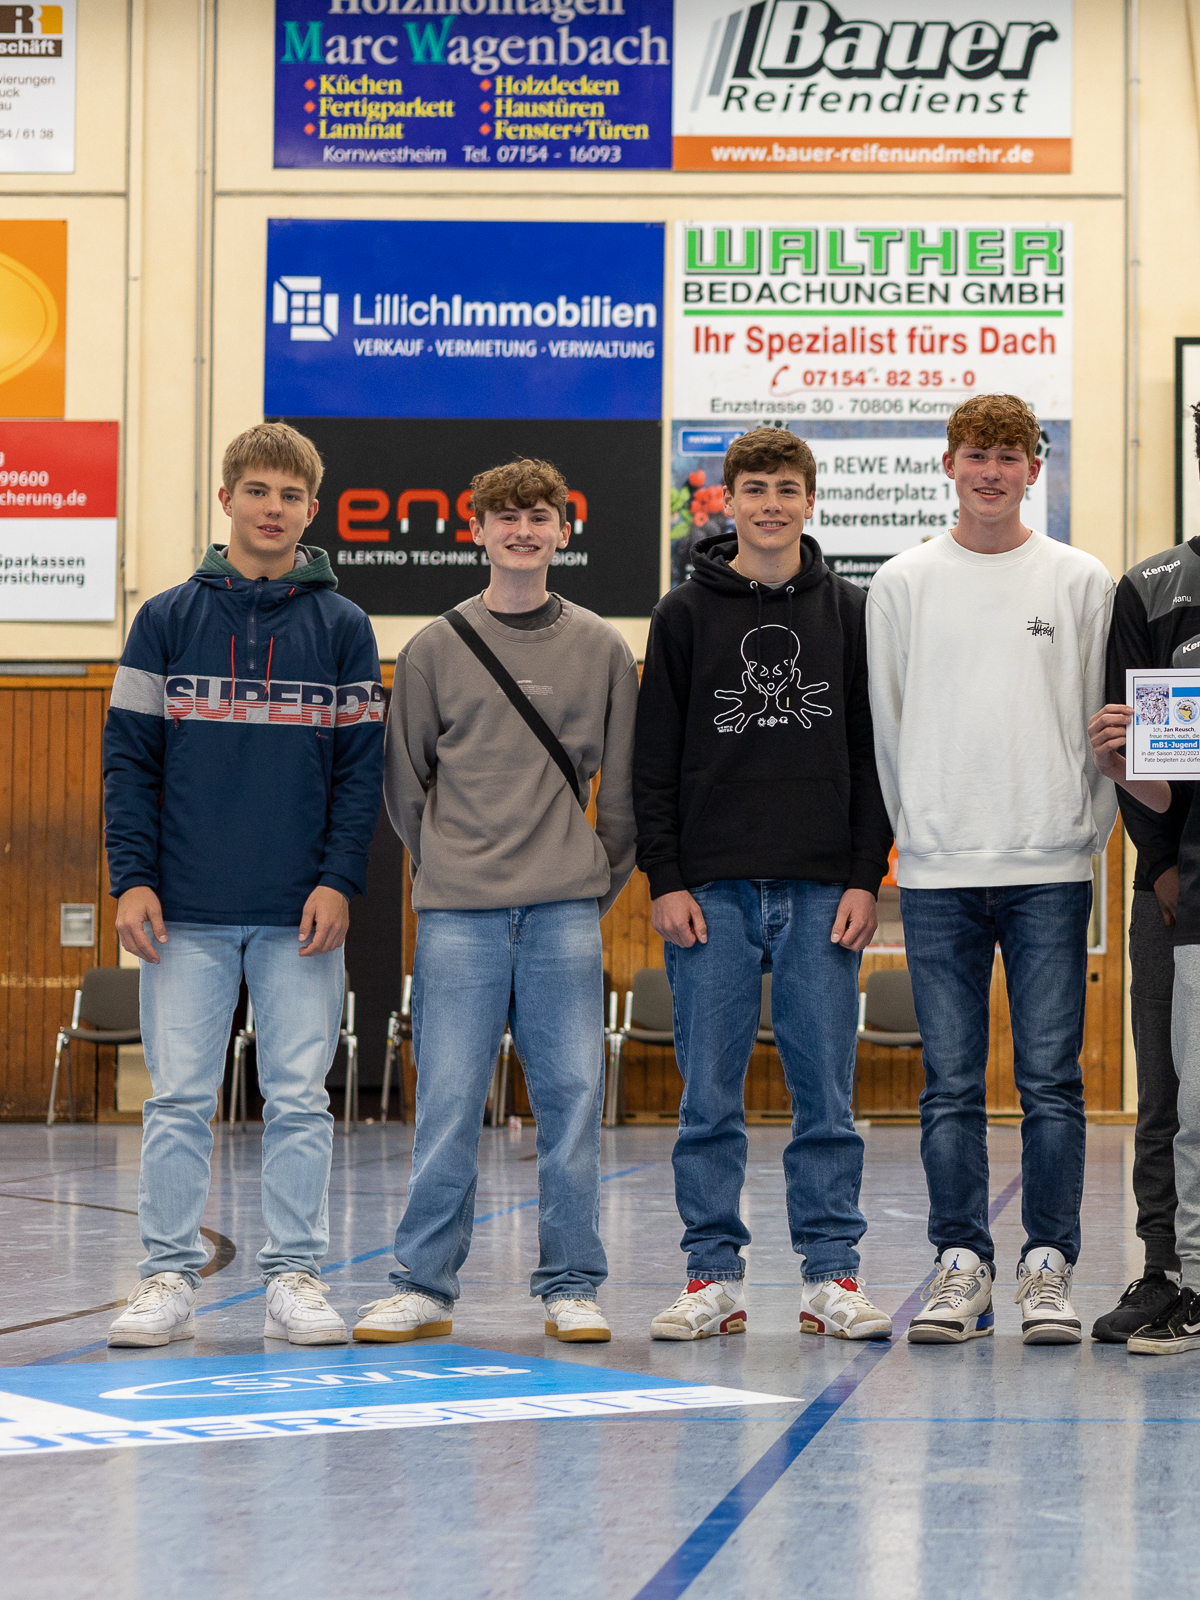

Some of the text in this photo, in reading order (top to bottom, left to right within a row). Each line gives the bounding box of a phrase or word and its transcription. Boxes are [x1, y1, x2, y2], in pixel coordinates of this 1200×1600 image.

[280, 15, 670, 75] Marc Wagenbach
[758, 0, 1058, 79] Bauer
[319, 75, 402, 95] Küchen
[494, 75, 620, 96] Holzdecken
[319, 97, 455, 122] Fertigparkett
[494, 97, 605, 118] Haustüren
[722, 84, 1030, 114] Reifendienst
[319, 119, 404, 139] Laminat
[494, 119, 650, 140] Fenster+Türen
[322, 145, 447, 163] Kornwestheim
[462, 145, 491, 163] Tel.
[496, 145, 549, 163] 07154
[569, 145, 622, 163] 16093
[711, 143, 1034, 164] www.bauer-reifenundmehr.de
[684, 228, 1064, 276] WALTHER
[684, 282, 1064, 304] BEDACHUNGEN GMBH
[354, 294, 657, 328] LillichImmobilien
[353, 339, 655, 358] VERKAUF VERMIETUNG VERWALTUNG
[694, 325, 1056, 361] Ihr Spezialist fürs Dach
[802, 370, 975, 387] 07154 82 35 0
[710, 399, 806, 414] Enzstrasse
[811, 399, 834, 414] 30
[850, 399, 904, 414] 70806
[834, 457, 888, 474] REWE
[816, 483, 936, 504] amanderplatz
[820, 509, 947, 527] beerenstarkes
[337, 551, 407, 565] ELEKTRO
[411, 552, 477, 565] TECHNIK
[551, 553, 588, 566] SIGN
[1142, 559, 1181, 579] Kempa
[1152, 741, 1198, 750] mB1-Jugend
